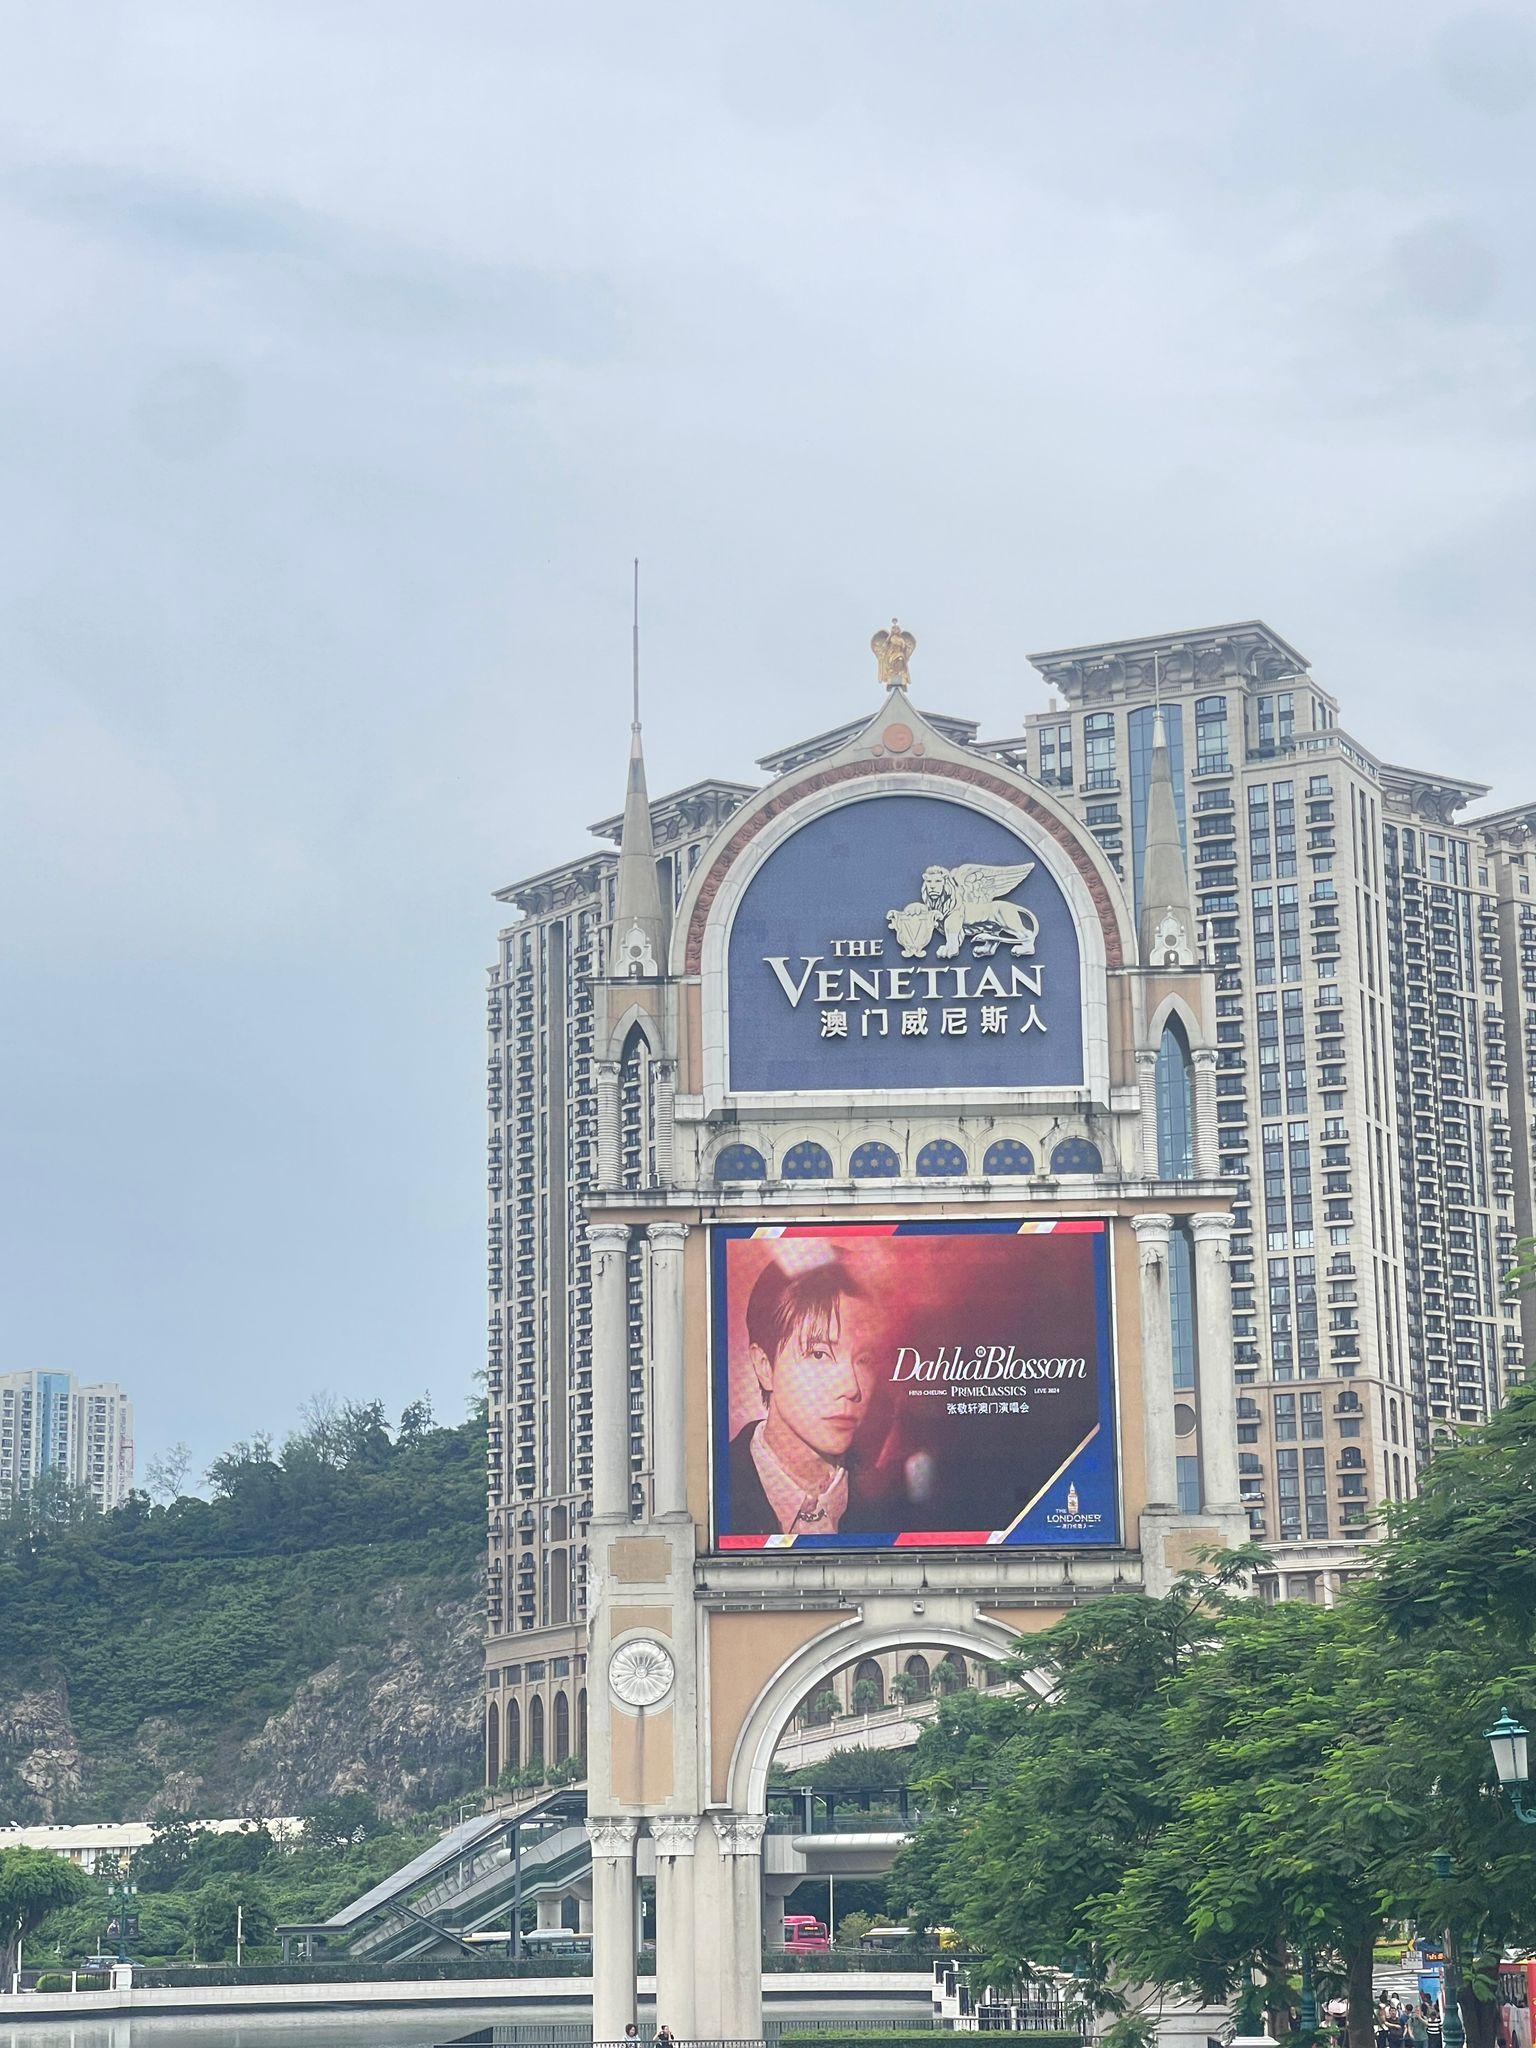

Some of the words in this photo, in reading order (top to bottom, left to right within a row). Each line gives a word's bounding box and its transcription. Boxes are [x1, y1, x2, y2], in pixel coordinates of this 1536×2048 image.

[830, 938, 884, 957] THE
[763, 956, 1046, 1008] VENETIAN
[820, 1004, 1047, 1038] 澳门威尼斯人
[946, 1401, 1030, 1415] 张敬轩澳门演唱会
[1046, 1514, 1102, 1523] LONDONER
